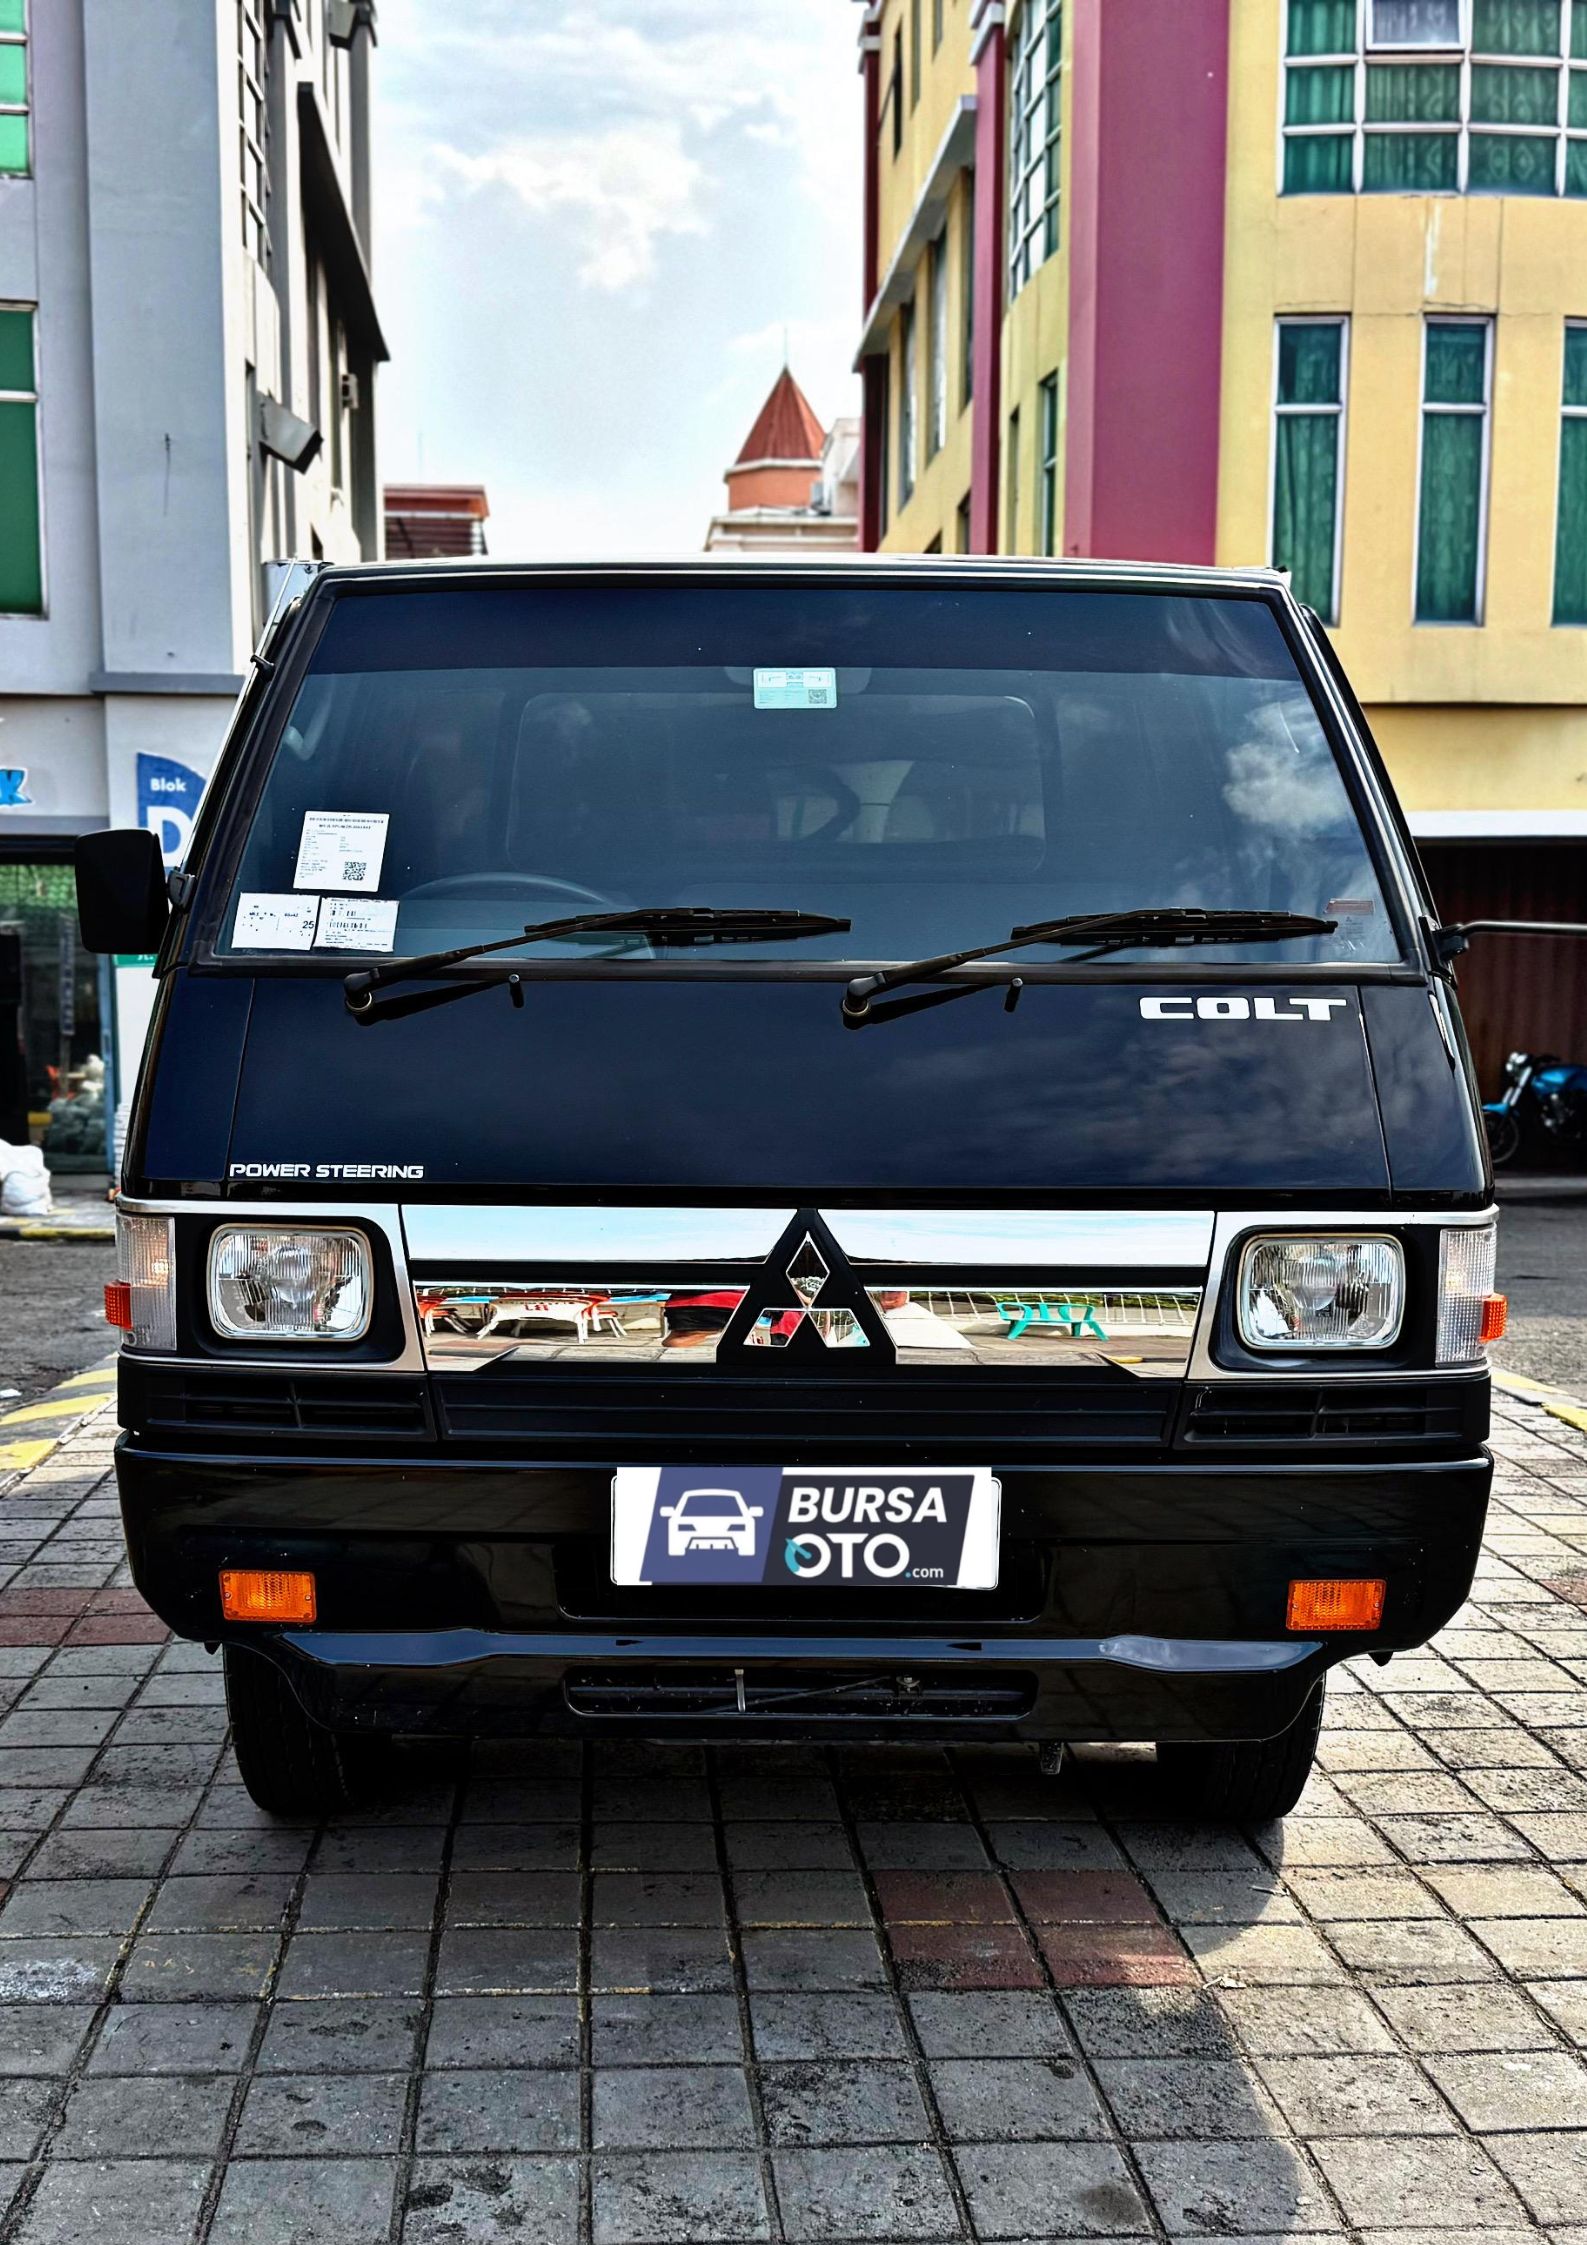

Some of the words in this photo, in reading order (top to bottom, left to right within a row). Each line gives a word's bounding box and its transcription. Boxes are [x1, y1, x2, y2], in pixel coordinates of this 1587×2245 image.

[150, 778, 187, 792] Blok
[147, 806, 194, 867] D
[302, 920, 315, 929] 25
[1139, 997, 1347, 1021] COLT
[229, 1163, 311, 1178] POWER
[315, 1164, 424, 1179] STEERING
